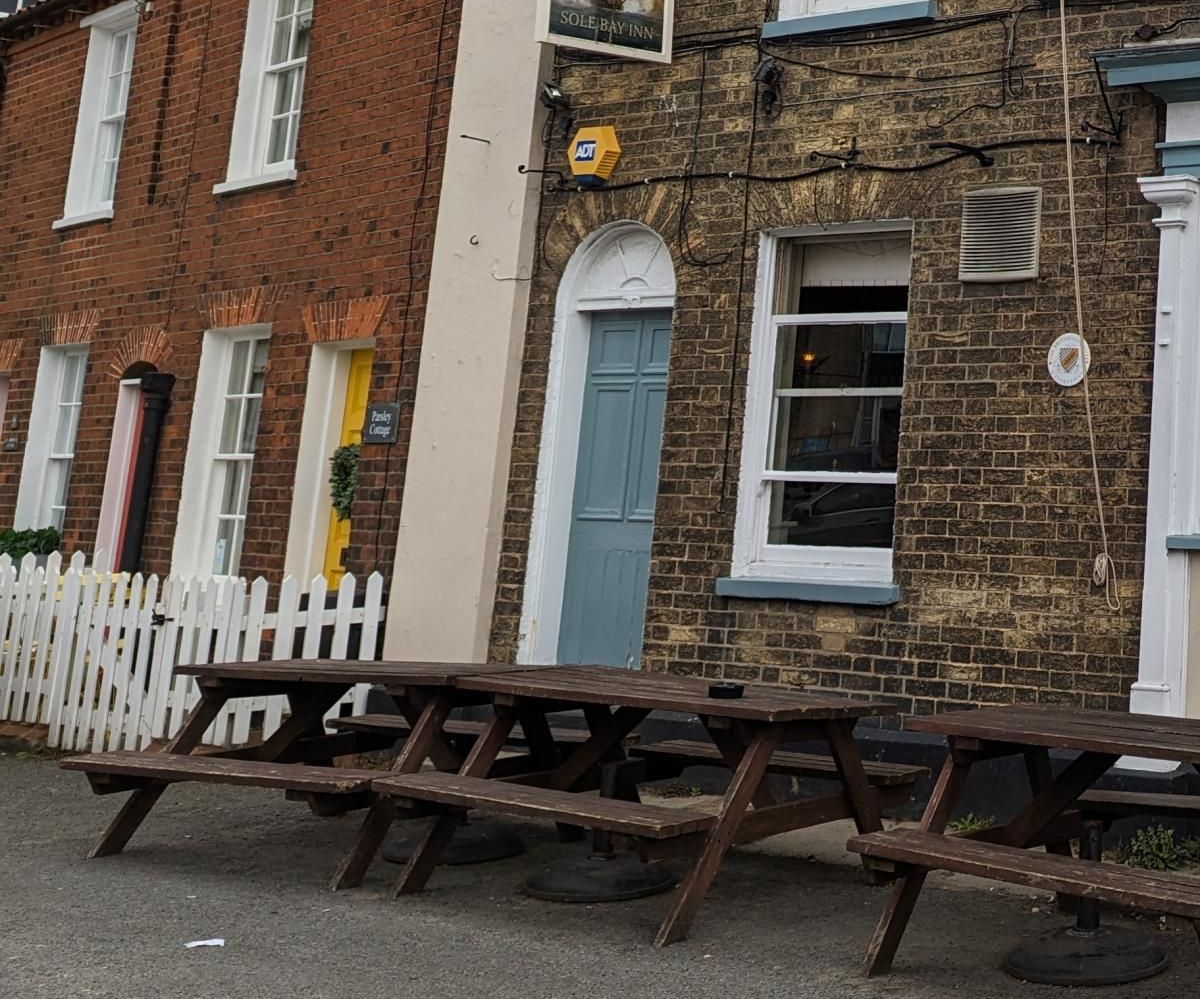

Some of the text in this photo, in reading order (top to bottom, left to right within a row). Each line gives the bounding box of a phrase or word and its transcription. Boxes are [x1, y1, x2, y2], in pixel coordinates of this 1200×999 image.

[560, 10, 653, 40] SOLE BAY INN
[575, 143, 597, 159] ADT
